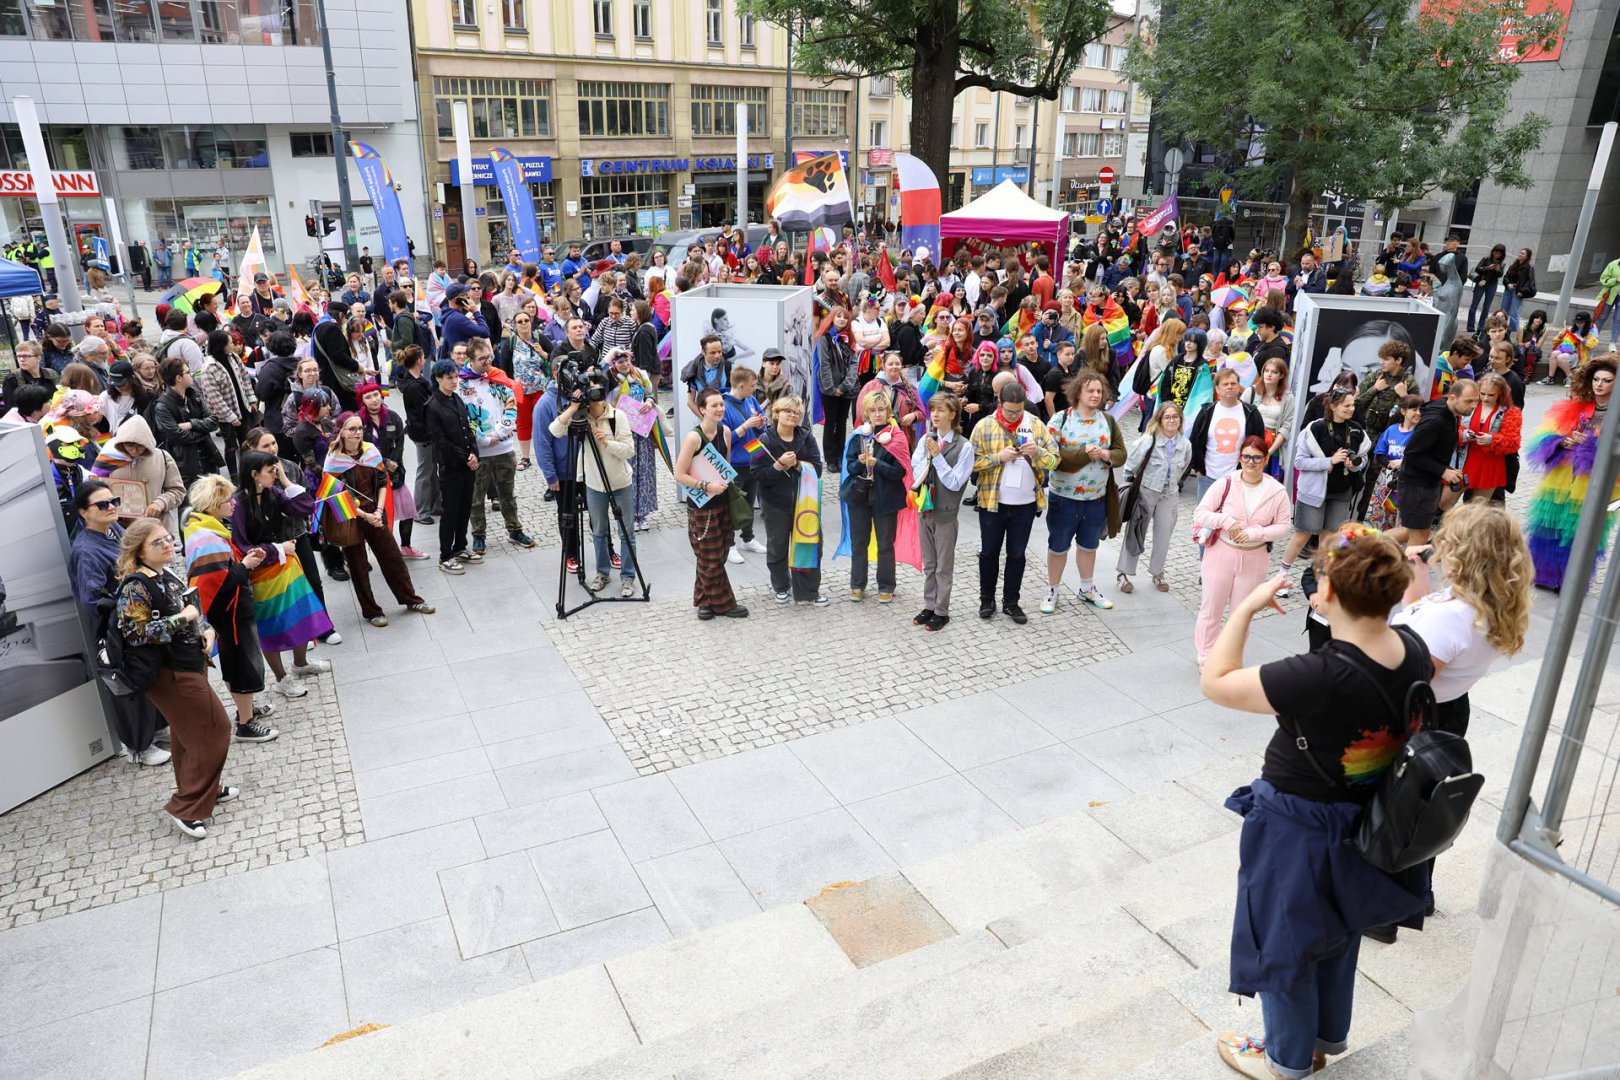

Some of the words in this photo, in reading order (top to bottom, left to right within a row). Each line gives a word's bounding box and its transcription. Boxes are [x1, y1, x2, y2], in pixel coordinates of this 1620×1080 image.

[600, 158, 689, 173] CENTRUM
[695, 156, 760, 171] KSIĄKI
[703, 447, 732, 481] TRANS
